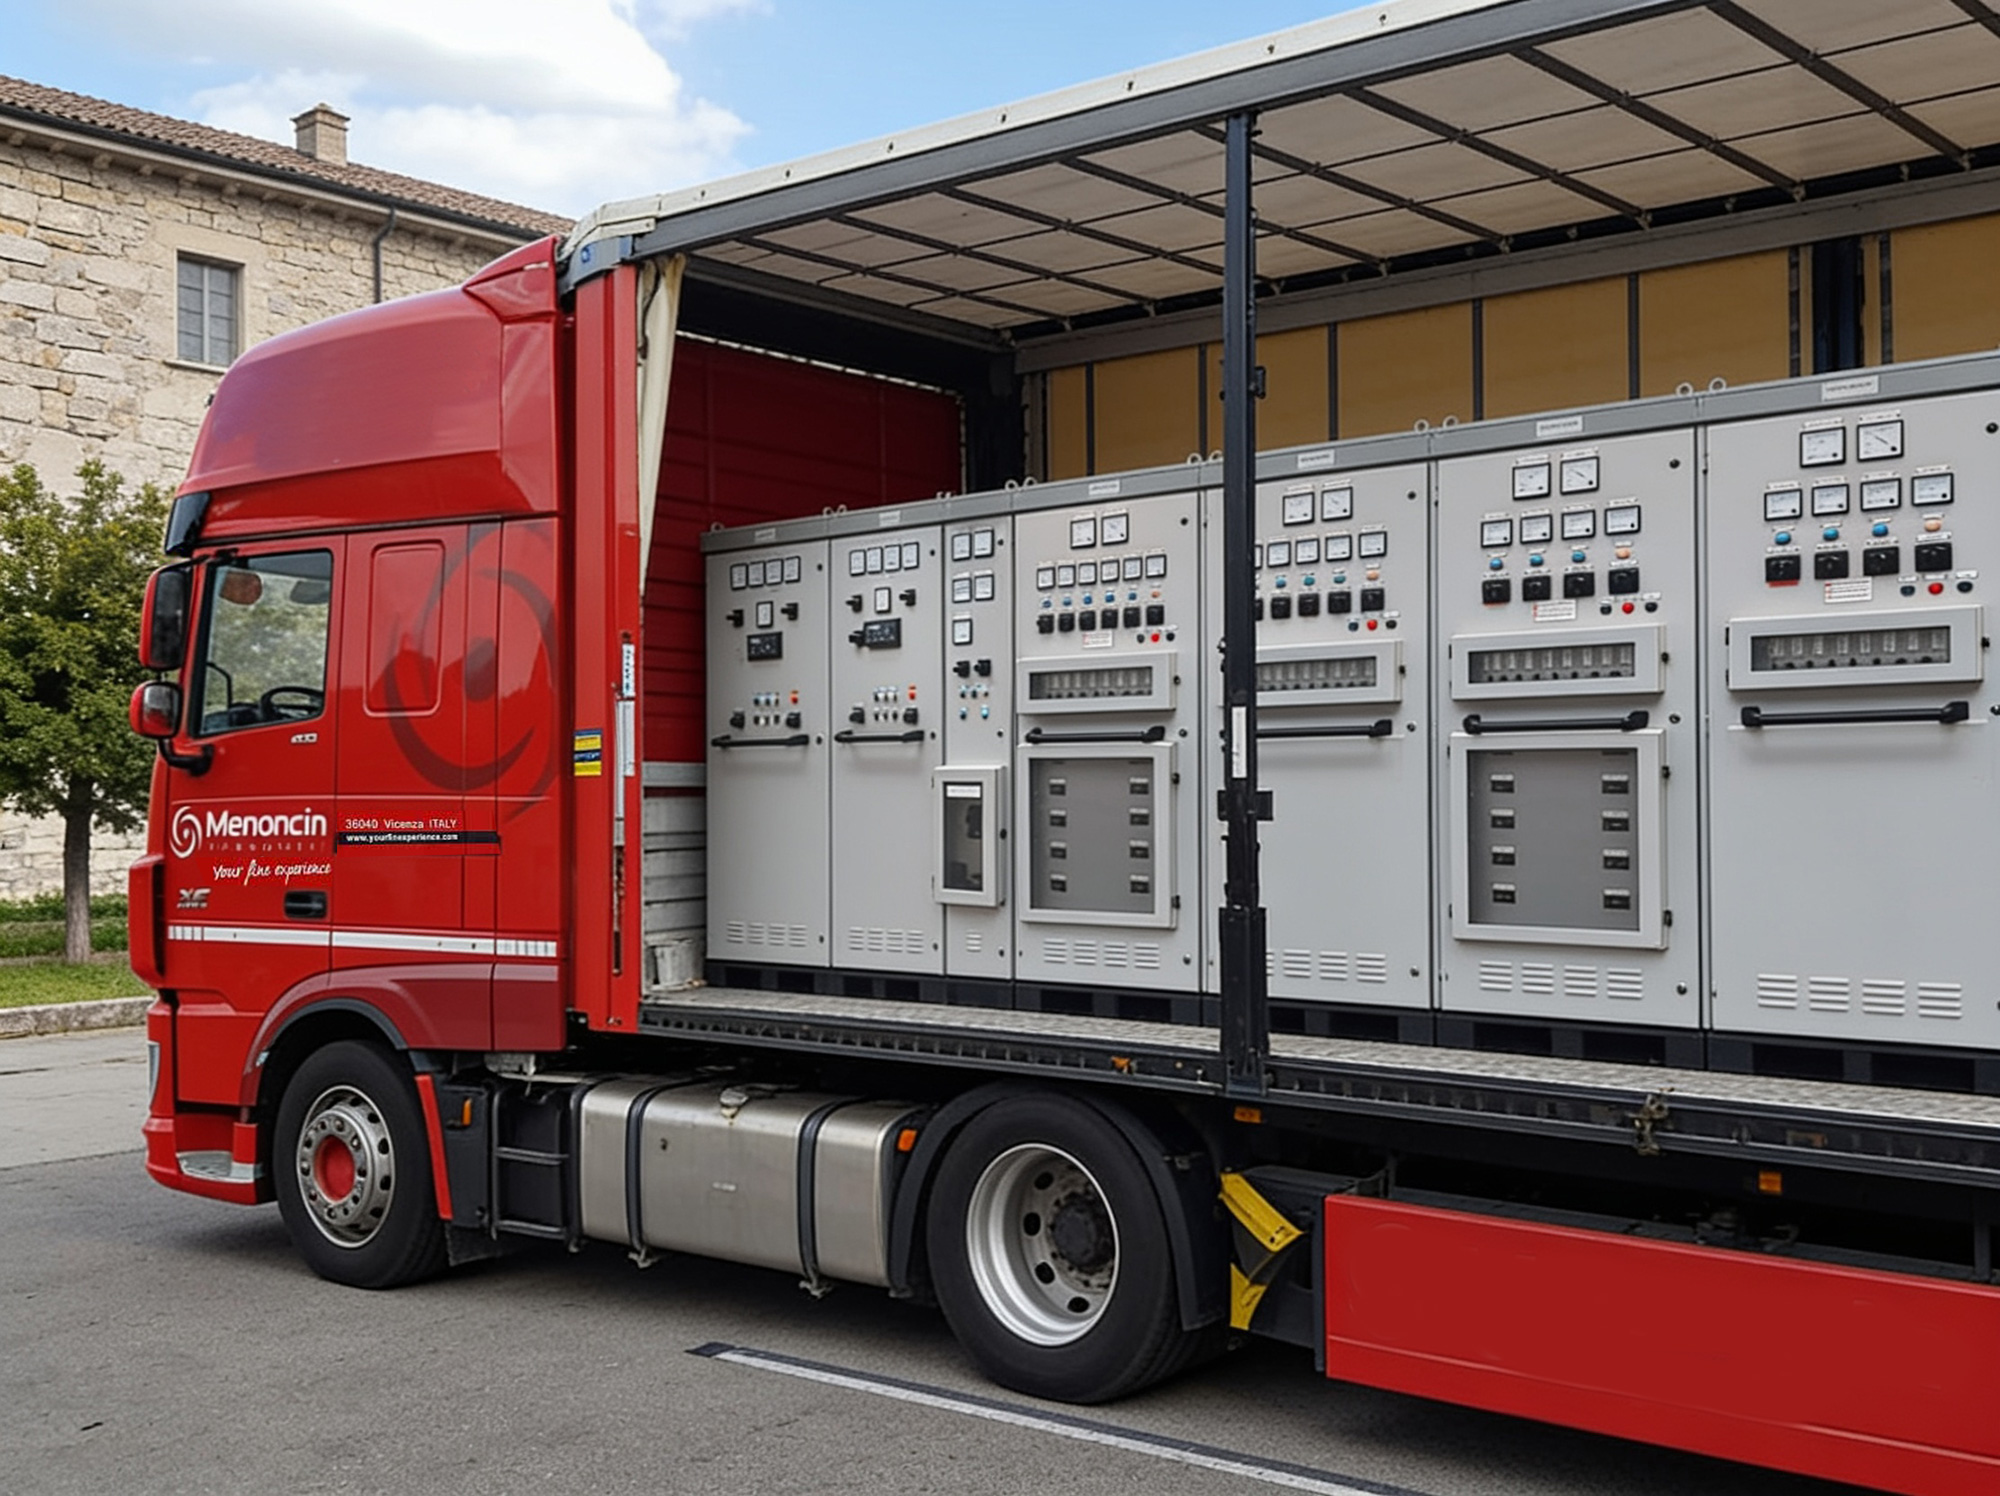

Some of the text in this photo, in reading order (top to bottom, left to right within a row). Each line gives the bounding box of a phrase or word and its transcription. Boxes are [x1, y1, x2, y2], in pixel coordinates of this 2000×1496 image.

[206, 807, 327, 838] Menoncin
[345, 818, 457, 829] 36040 Vicenza ITALY
[243, 858, 271, 886] fine
[275, 862, 331, 885] experience
